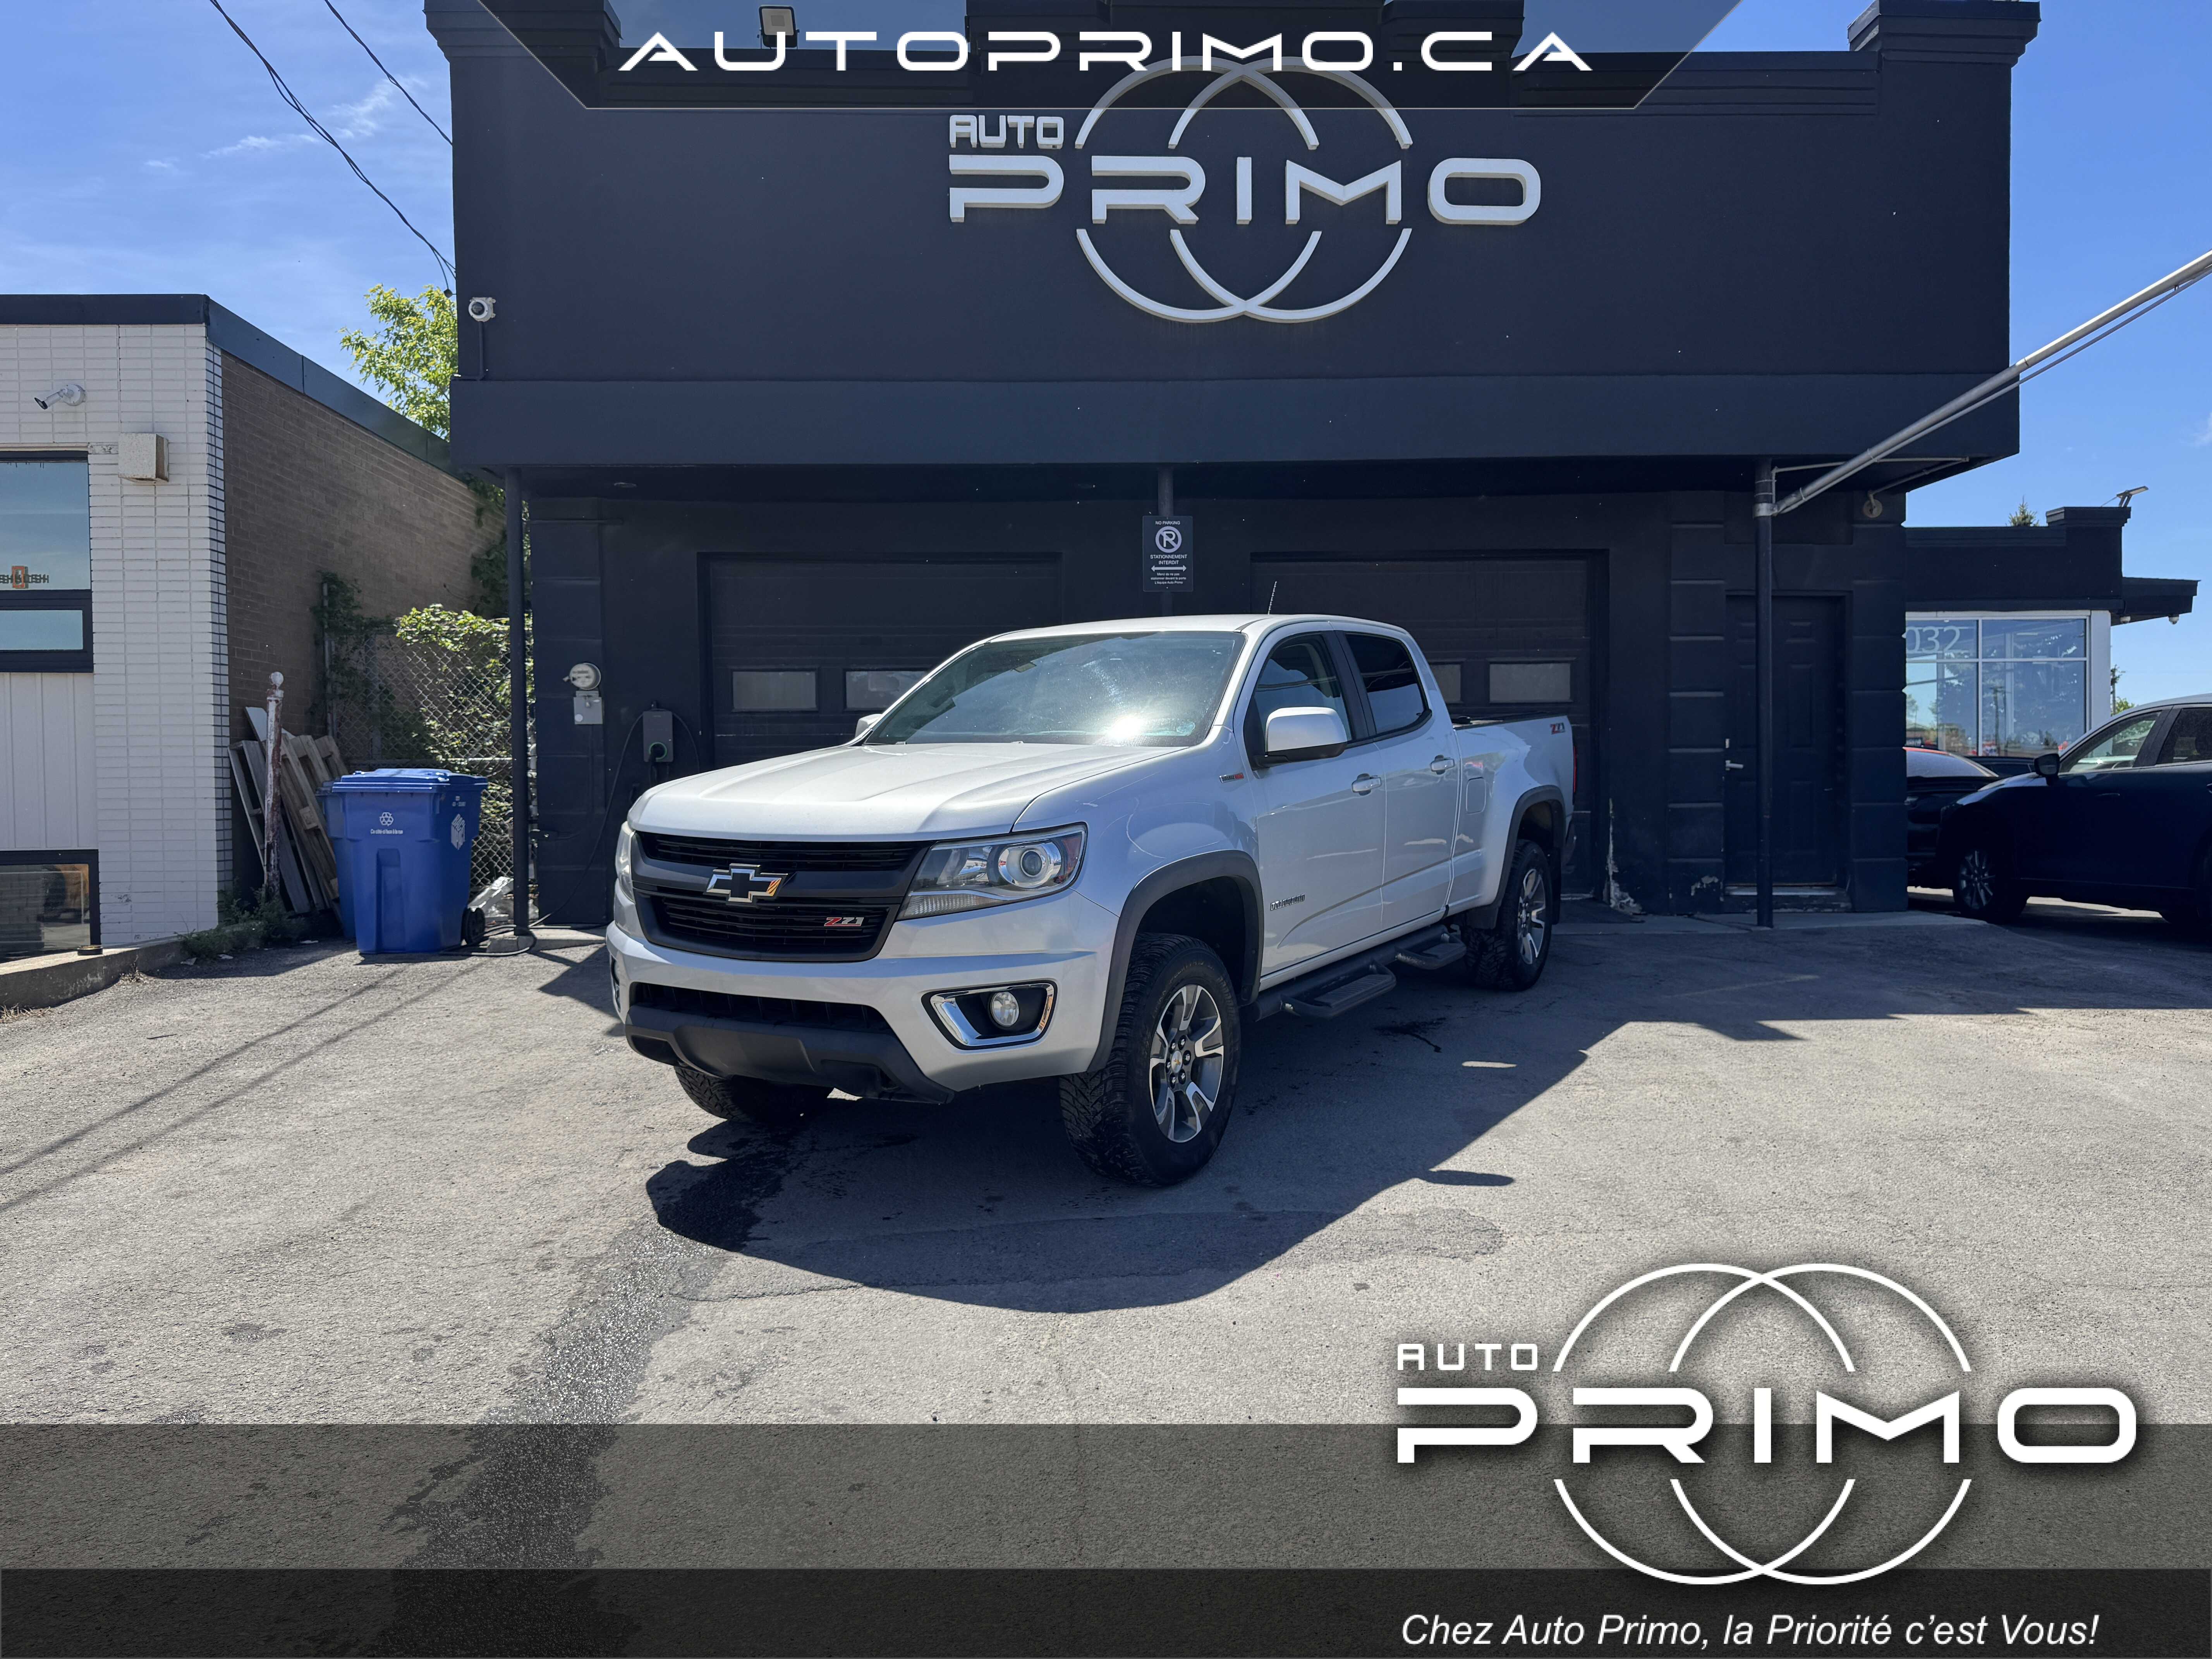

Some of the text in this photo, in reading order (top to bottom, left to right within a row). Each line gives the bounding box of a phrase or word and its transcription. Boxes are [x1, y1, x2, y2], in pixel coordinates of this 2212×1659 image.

[949, 115, 1064, 149] AUTO
[949, 154, 1541, 225] PRIMO
[824, 917, 864, 927] Z71
